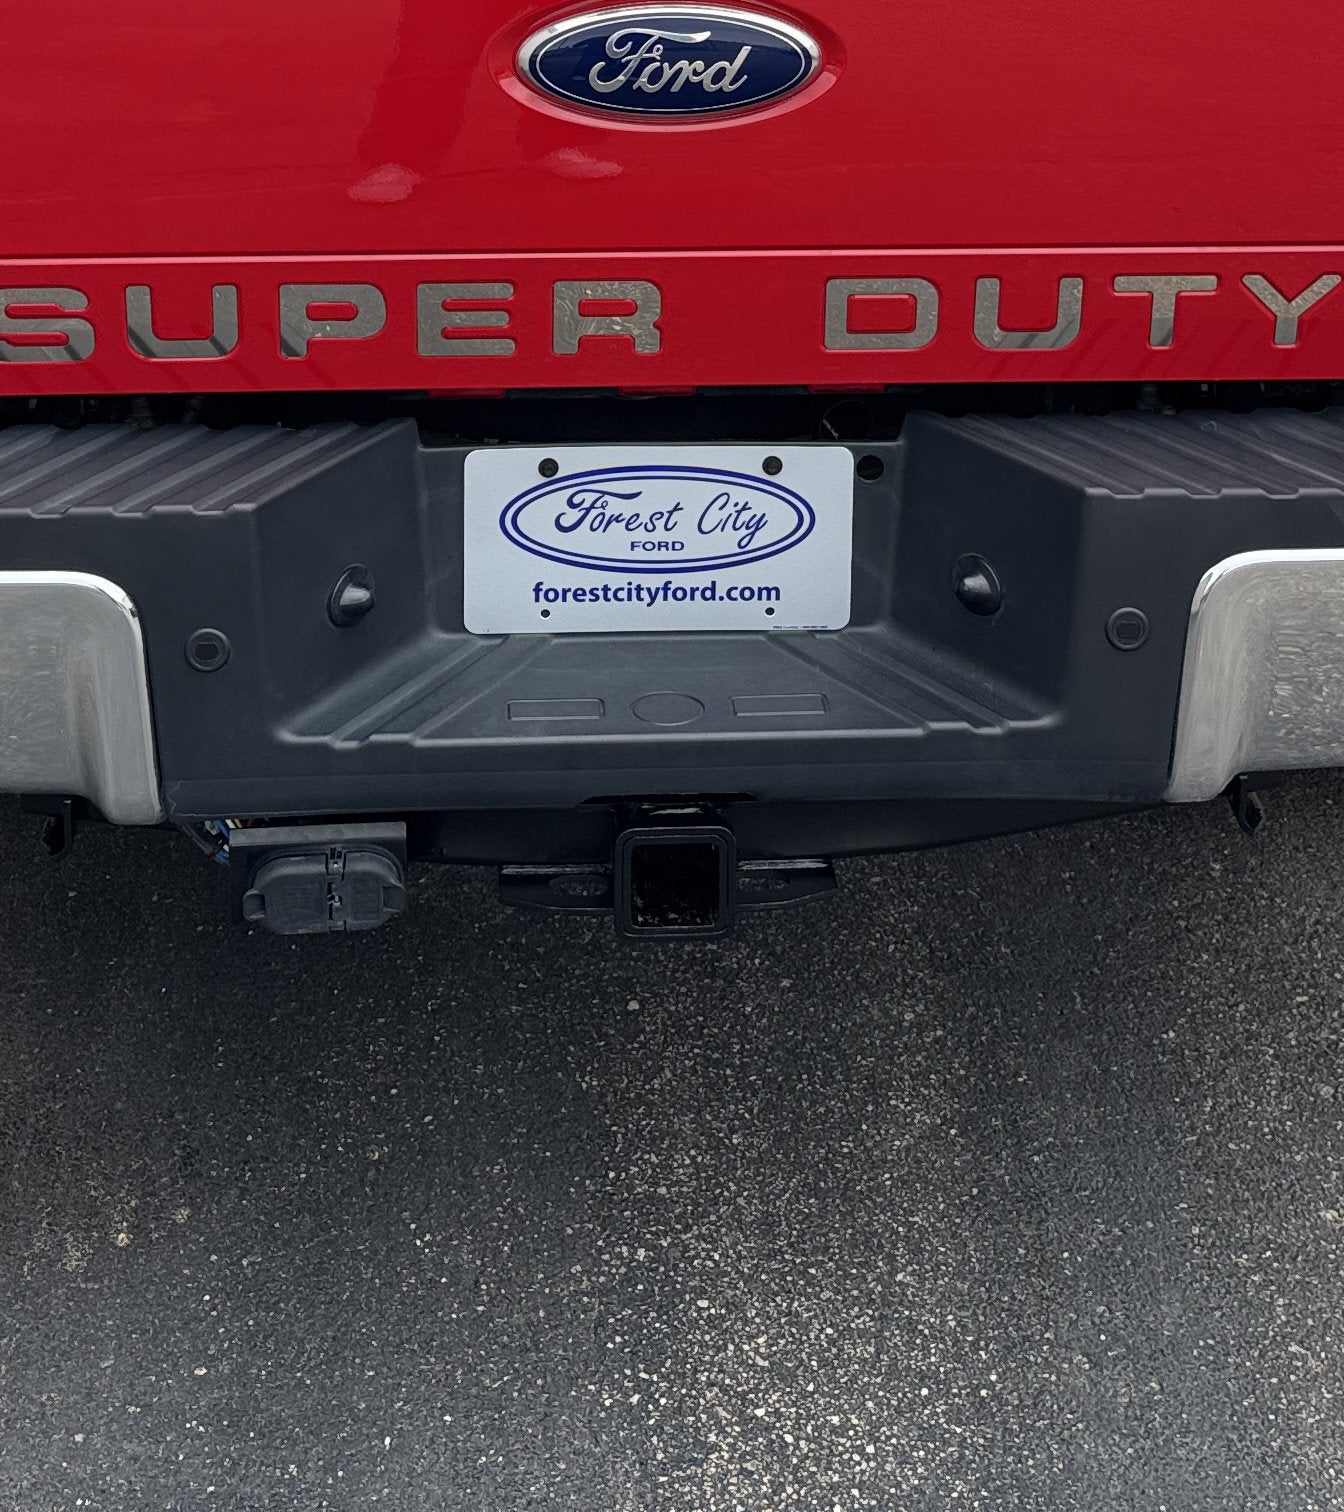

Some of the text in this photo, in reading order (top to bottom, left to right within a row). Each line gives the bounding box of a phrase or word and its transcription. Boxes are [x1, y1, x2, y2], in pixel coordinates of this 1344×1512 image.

[588, 27, 752, 93] Ford
[822, 273, 1344, 352] DUTY
[554, 488, 769, 550] Forest City
[629, 540, 685, 552] FORD
[532, 580, 781, 607] forestcityford.com
